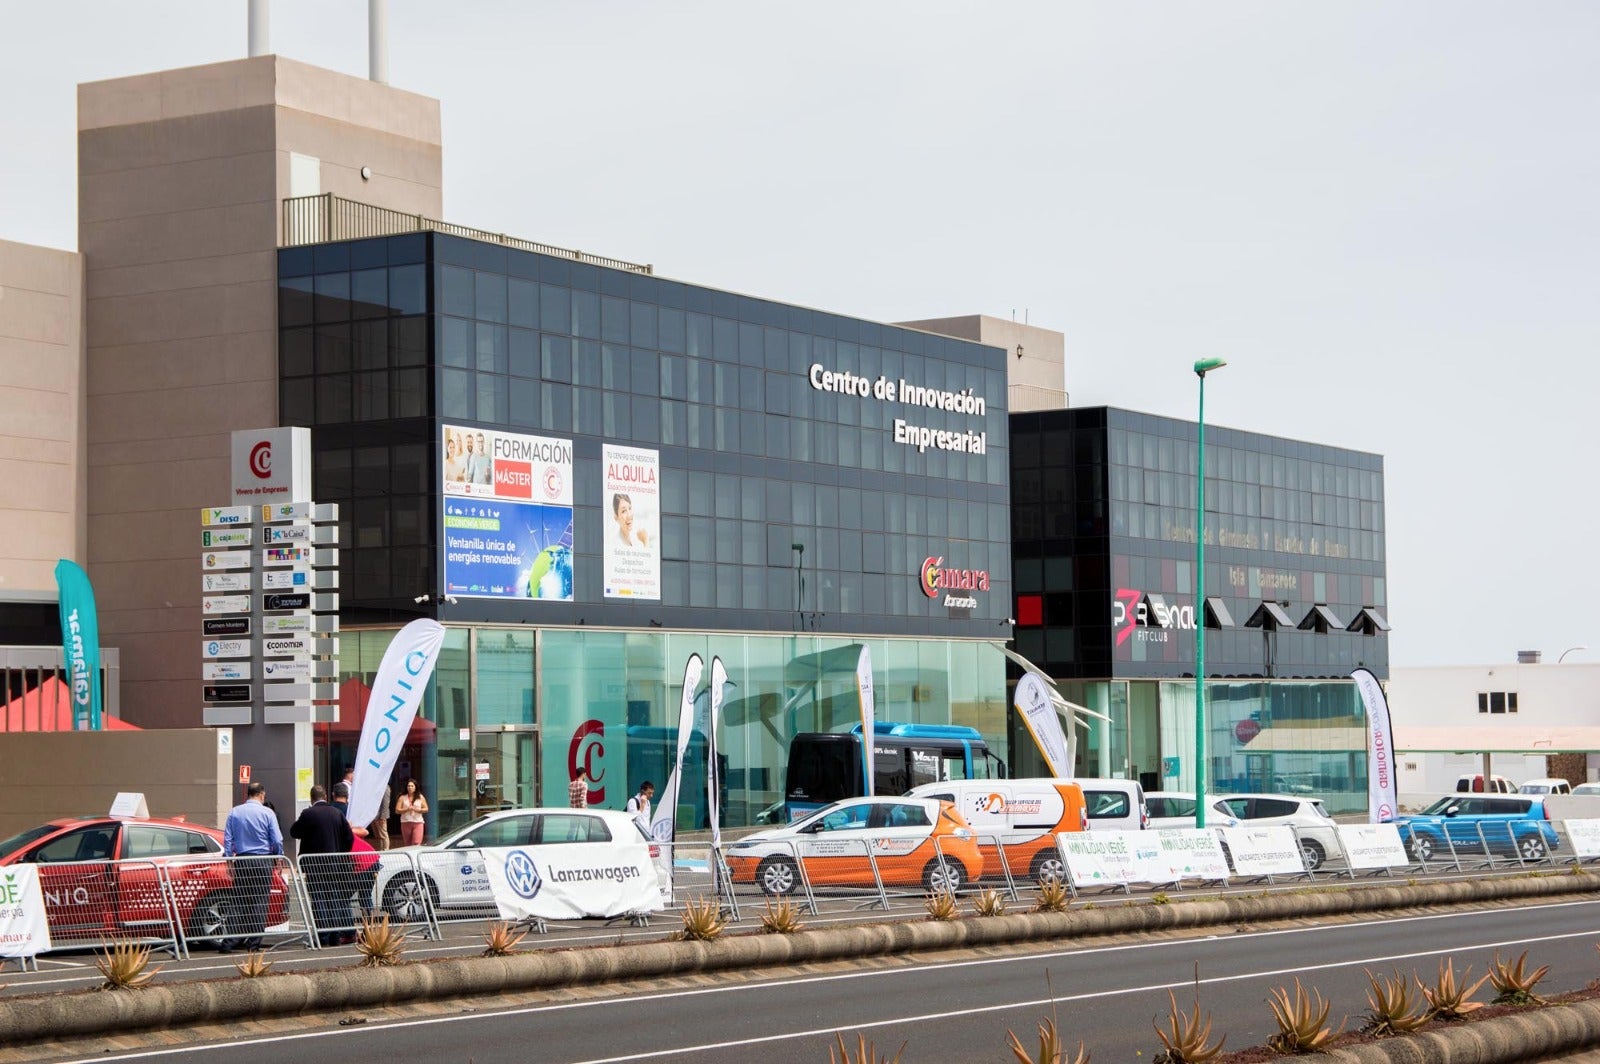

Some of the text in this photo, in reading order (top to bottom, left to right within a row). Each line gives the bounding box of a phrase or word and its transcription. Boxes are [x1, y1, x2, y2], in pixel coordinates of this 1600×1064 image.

[809, 363, 986, 416] Centro de Innovación
[894, 419, 986, 455] Empresarial
[494, 438, 571, 464] FORMACIÓN
[495, 468, 531, 486] MÁSTER
[608, 463, 656, 484] ALQUILA
[236, 487, 254, 496] Vivero
[263, 485, 288, 495] Empresas
[447, 535, 516, 552] Ventanilla única de
[448, 551, 522, 565] energías renovables
[1229, 566, 1297, 589] Isla Lanzarote
[369, 650, 429, 769] IONIQ
[548, 864, 640, 883] Lanzawagen
